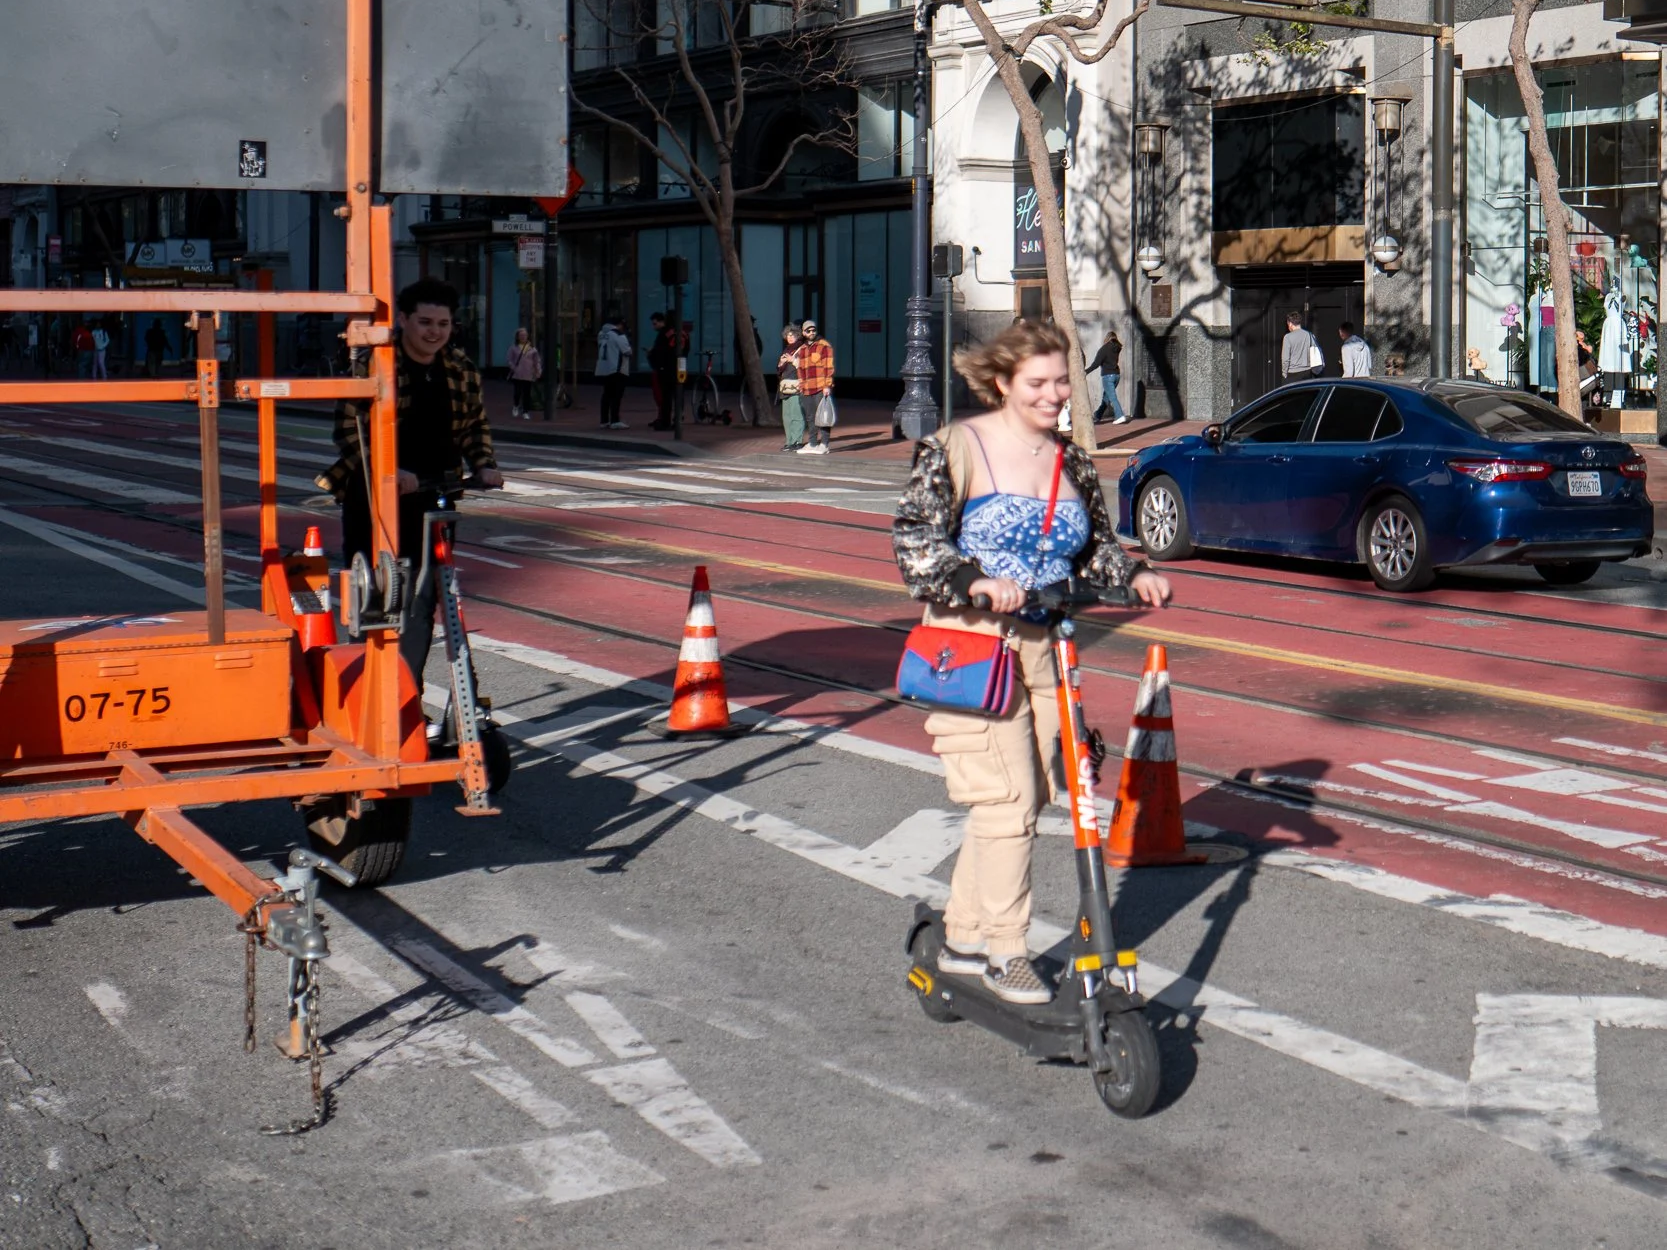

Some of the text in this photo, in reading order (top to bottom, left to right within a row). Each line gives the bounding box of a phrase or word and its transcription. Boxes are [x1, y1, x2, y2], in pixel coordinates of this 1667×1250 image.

[502, 223, 534, 231] POWELL
[1021, 240, 1041, 254] SAN
[65, 687, 171, 722] 07-75
[1076, 756, 1097, 831] SPIN
